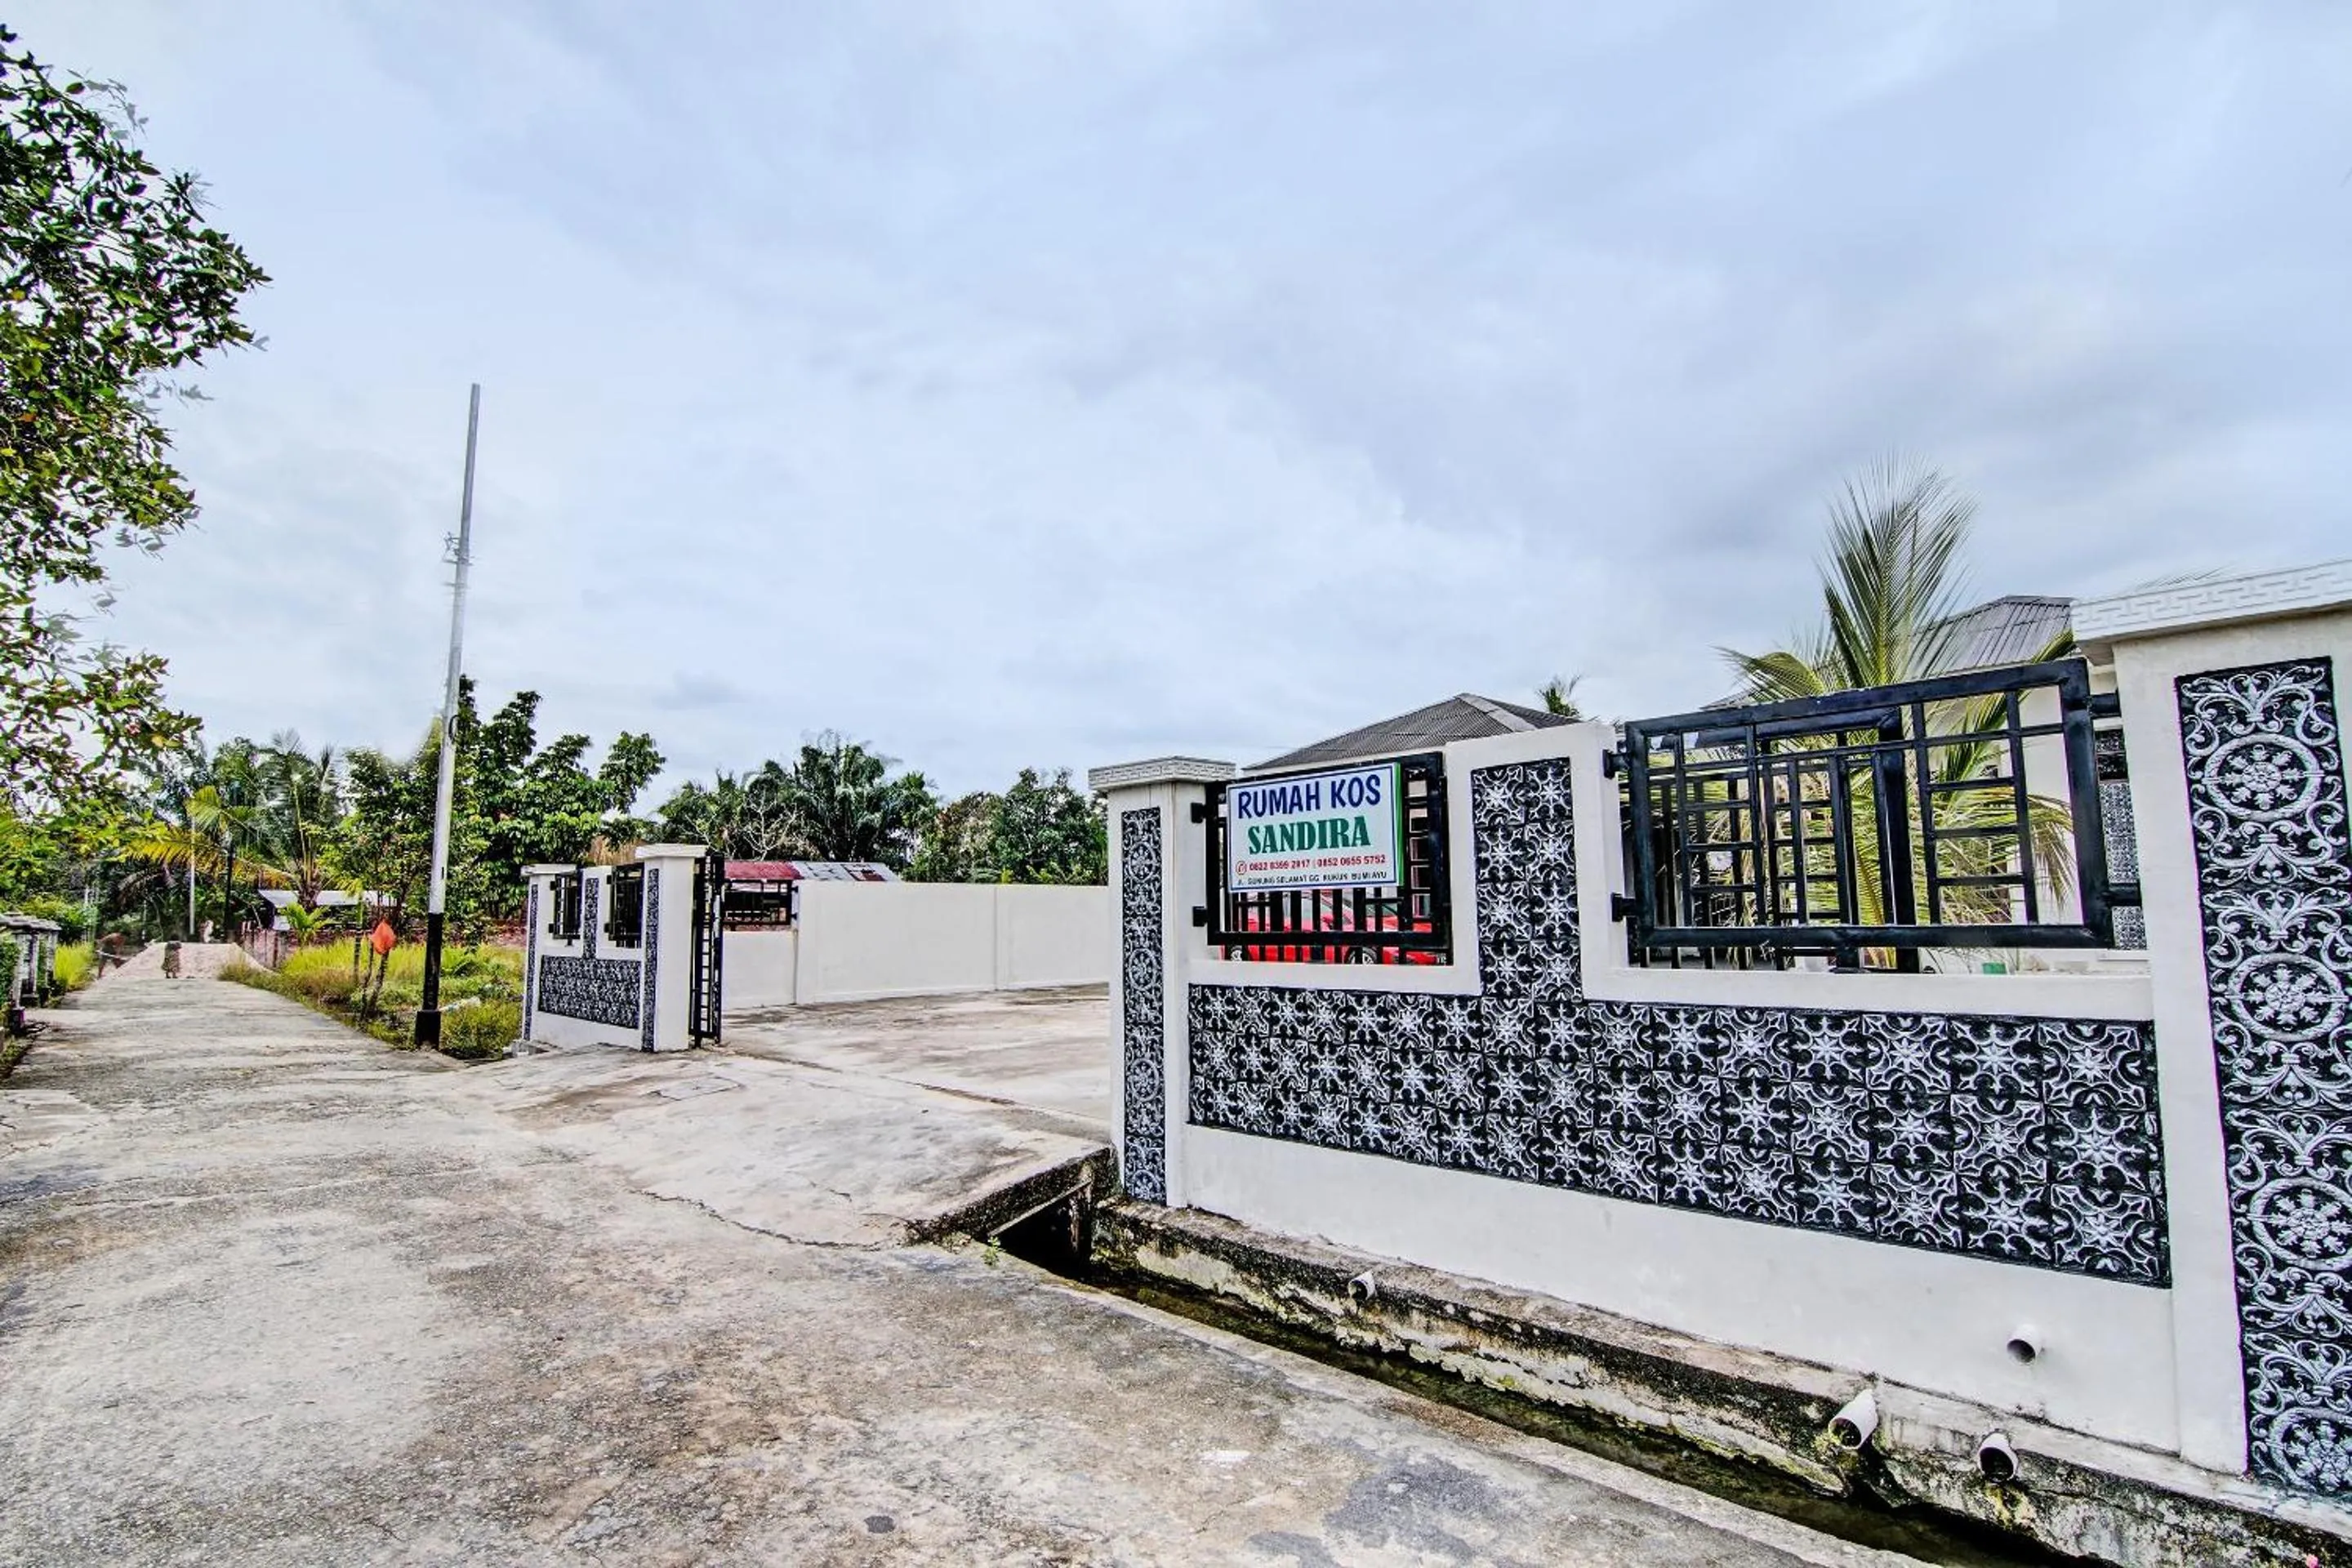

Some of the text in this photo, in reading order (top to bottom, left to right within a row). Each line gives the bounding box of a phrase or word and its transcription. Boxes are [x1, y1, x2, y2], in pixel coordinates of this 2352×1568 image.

[1238, 774, 1381, 819] RUMAH KOS
[1247, 815, 1370, 854] SANDIRA
[1316, 858, 1339, 867] 0852
